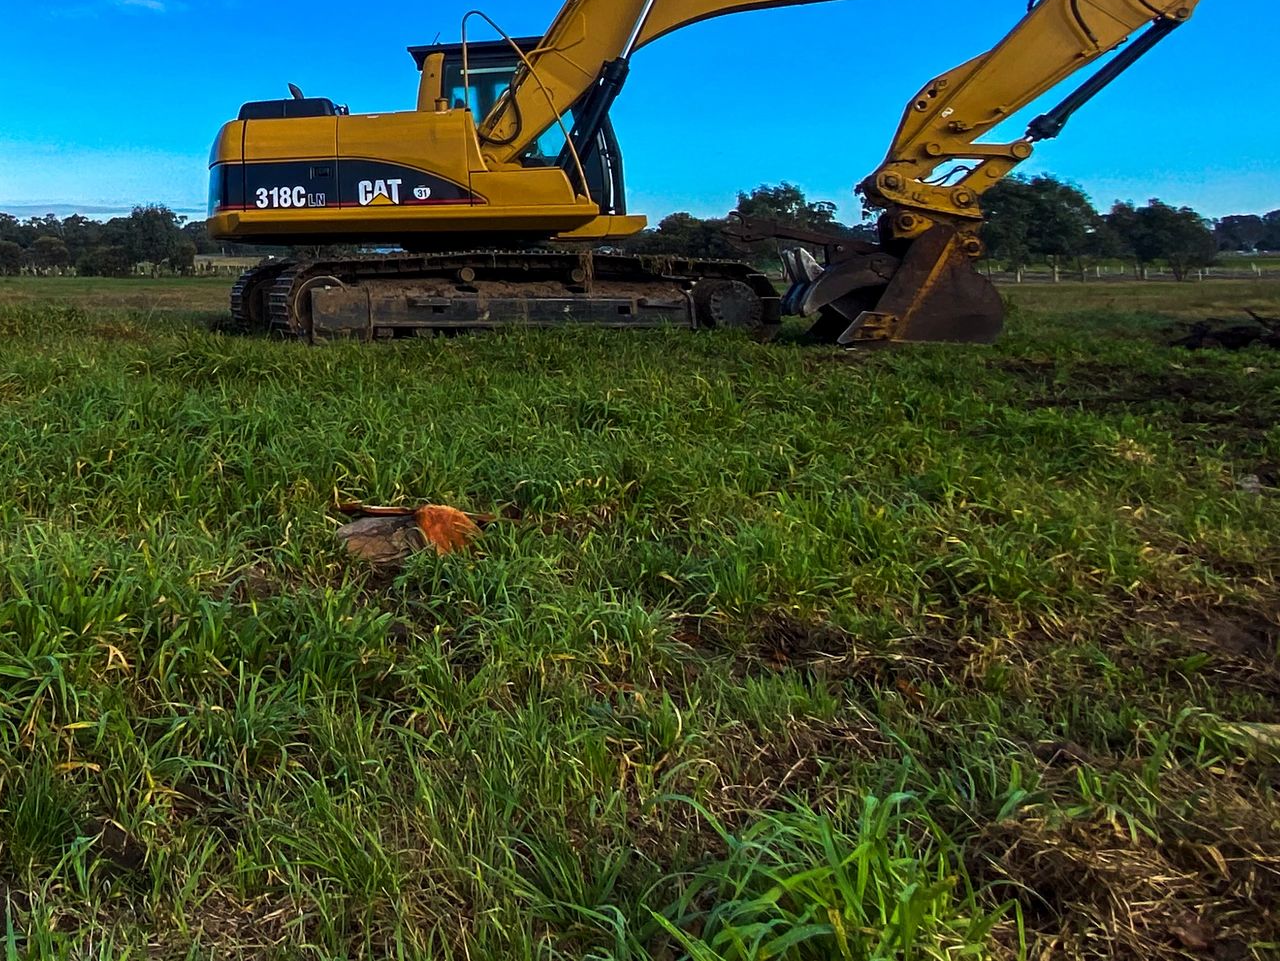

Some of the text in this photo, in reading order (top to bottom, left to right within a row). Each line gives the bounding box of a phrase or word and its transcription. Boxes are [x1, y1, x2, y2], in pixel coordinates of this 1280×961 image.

[255, 185, 307, 208] 318C
[358, 178, 403, 206] CAT
[417, 188, 427, 198] 31
